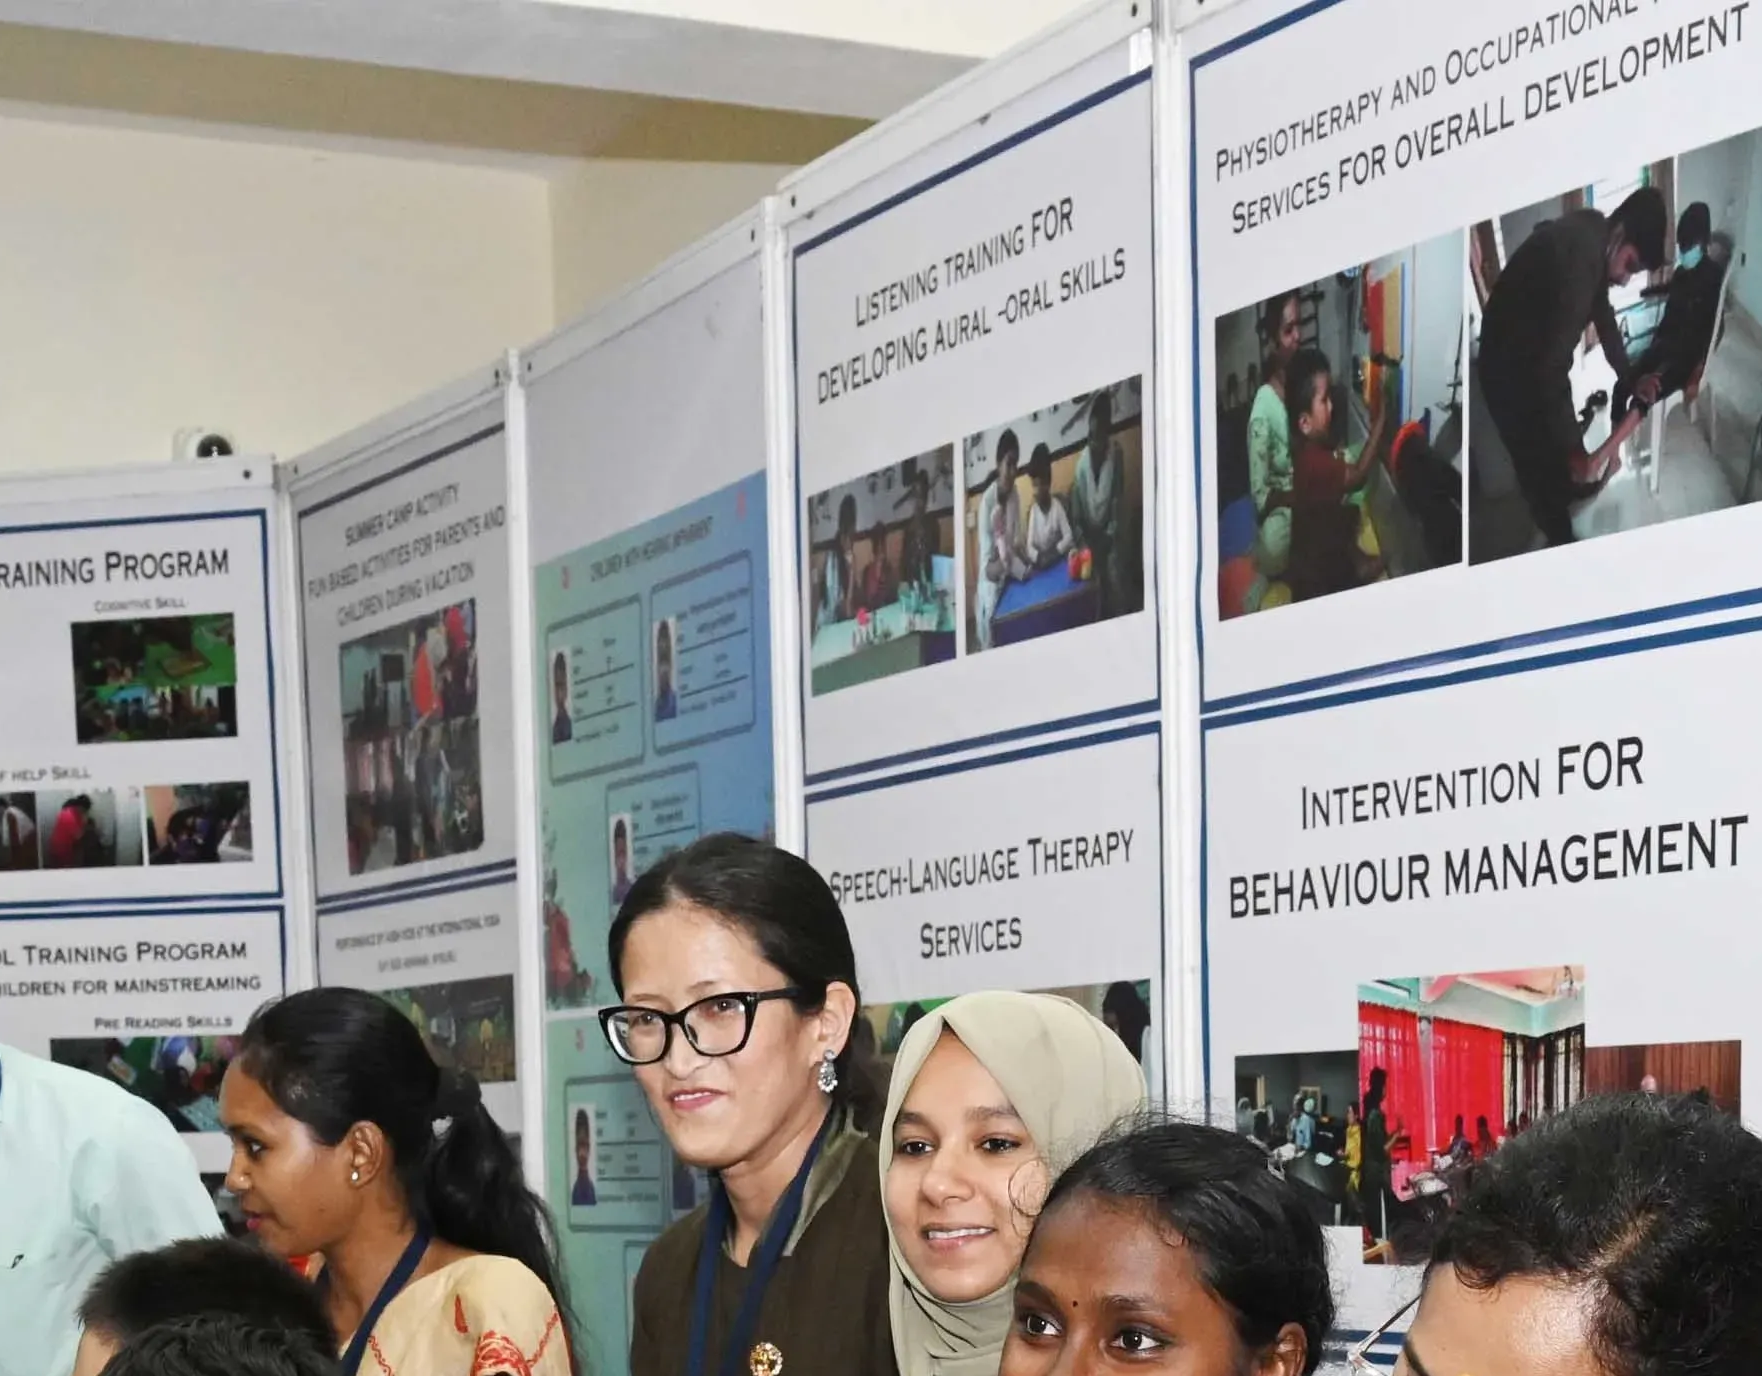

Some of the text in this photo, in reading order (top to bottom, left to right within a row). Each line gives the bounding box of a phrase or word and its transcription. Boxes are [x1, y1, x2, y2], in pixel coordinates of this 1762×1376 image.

[1215, 86, 1383, 183] PHYSIOTHERAPY
[1390, 65, 1437, 110] AND
[1232, 1, 1751, 235] SERVICES FOR OVERALL DEVELOPMENT
[855, 196, 1074, 328] LISTENING TRAINING FOR
[817, 326, 928, 406] DEVELOPING
[933, 308, 993, 354] AURAL
[1059, 247, 1126, 303] SKILLS
[104, 548, 229, 582] PROGRAM
[10, 767, 49, 782] HELP
[50, 765, 91, 781] SKILL
[1301, 735, 1644, 831] INTERVENTION FOR
[830, 828, 1134, 904] SPEECH-LANGUAGE THERAPY
[1229, 814, 1749, 920] BEHAVIOUR MANAGEMENT
[21, 940, 248, 966] TRAINING PROGRAM
[919, 916, 1023, 960] SERVICES
[71, 979, 109, 996] FOR
[113, 975, 262, 993] MAINSTREAMING
[123, 1016, 183, 1030] READING
[186, 1015, 234, 1029] SKILLS
